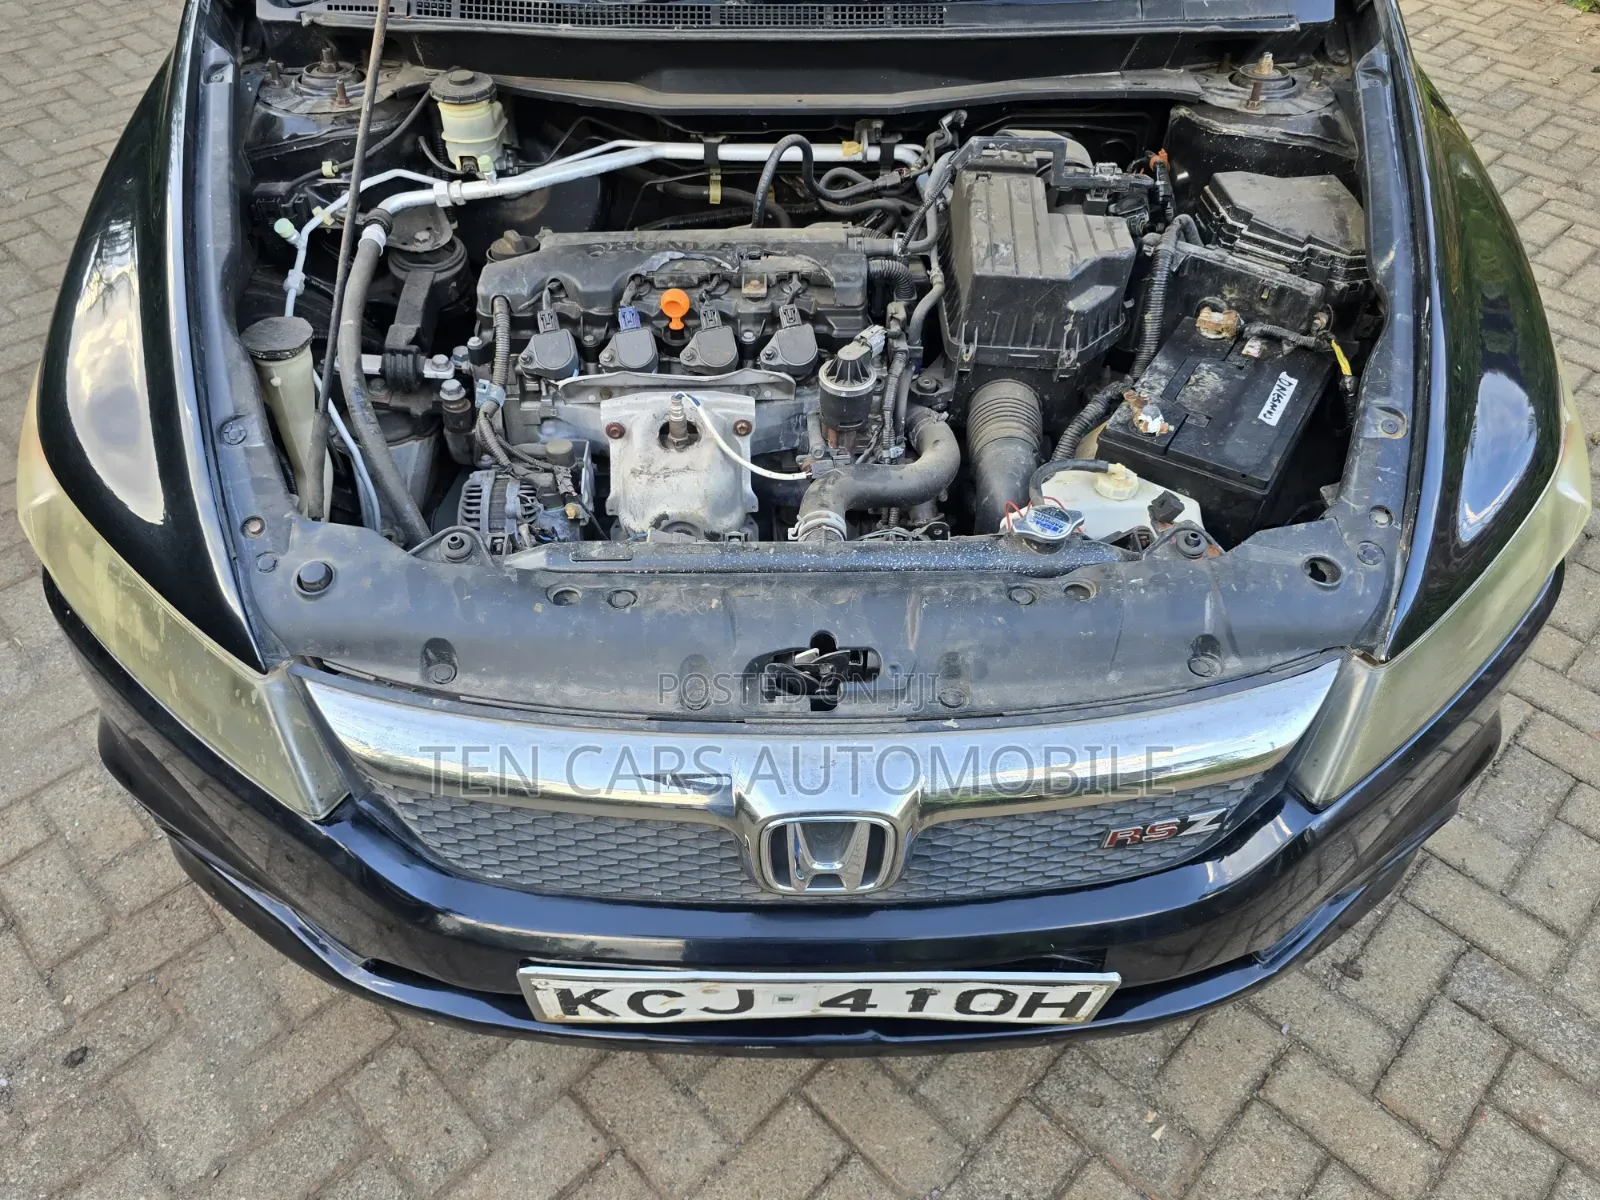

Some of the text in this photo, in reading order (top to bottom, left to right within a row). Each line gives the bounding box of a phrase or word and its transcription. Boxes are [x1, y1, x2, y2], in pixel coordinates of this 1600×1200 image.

[1103, 807, 1228, 849] RSZ
[553, 987, 1092, 1019] KCJ 410H
